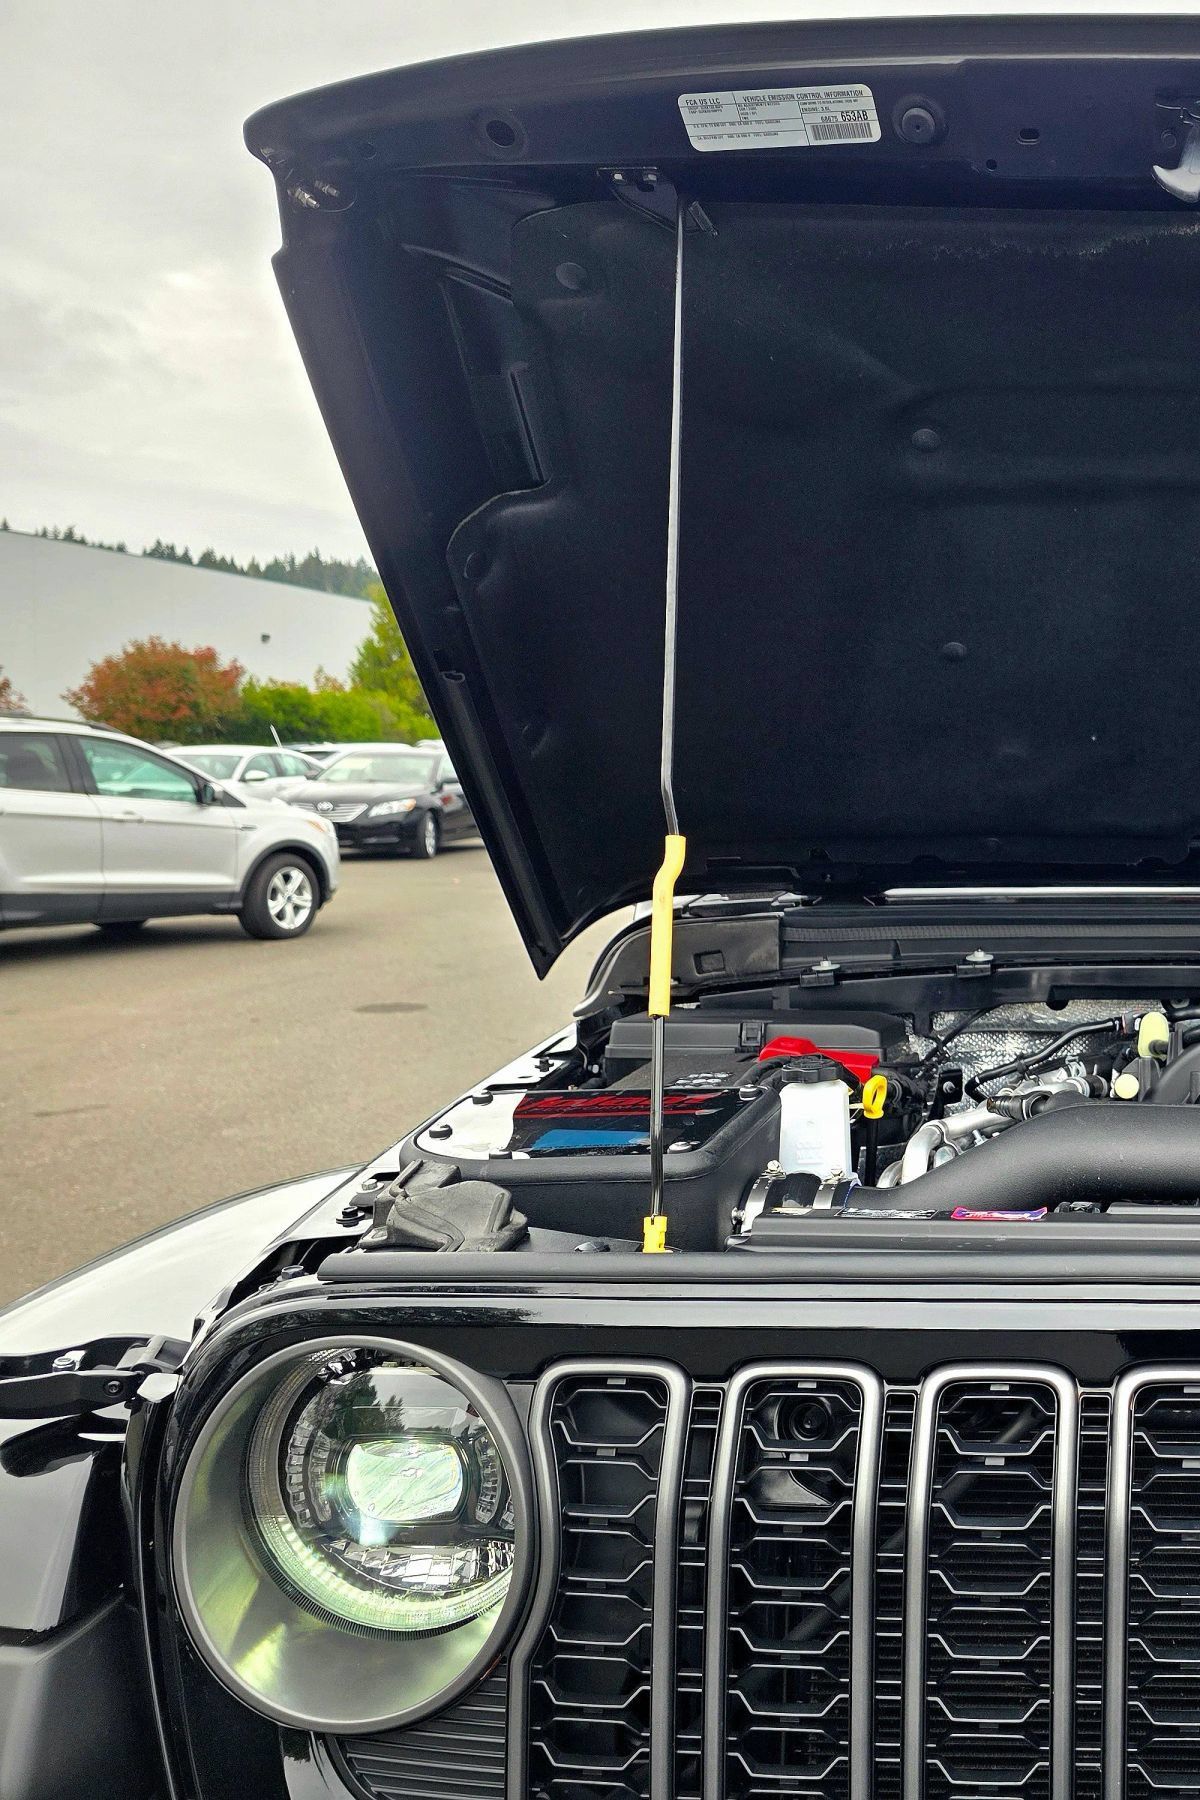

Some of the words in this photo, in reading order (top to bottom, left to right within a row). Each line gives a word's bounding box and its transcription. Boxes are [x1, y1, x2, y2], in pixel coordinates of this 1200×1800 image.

[708, 97, 721, 105] LLC
[742, 95, 766, 103] VEHICLE
[768, 93, 795, 102] EMISSION
[797, 92, 823, 100] CONTROL
[823, 89, 864, 98] INFORMATION
[840, 110, 869, 122] 653AB
